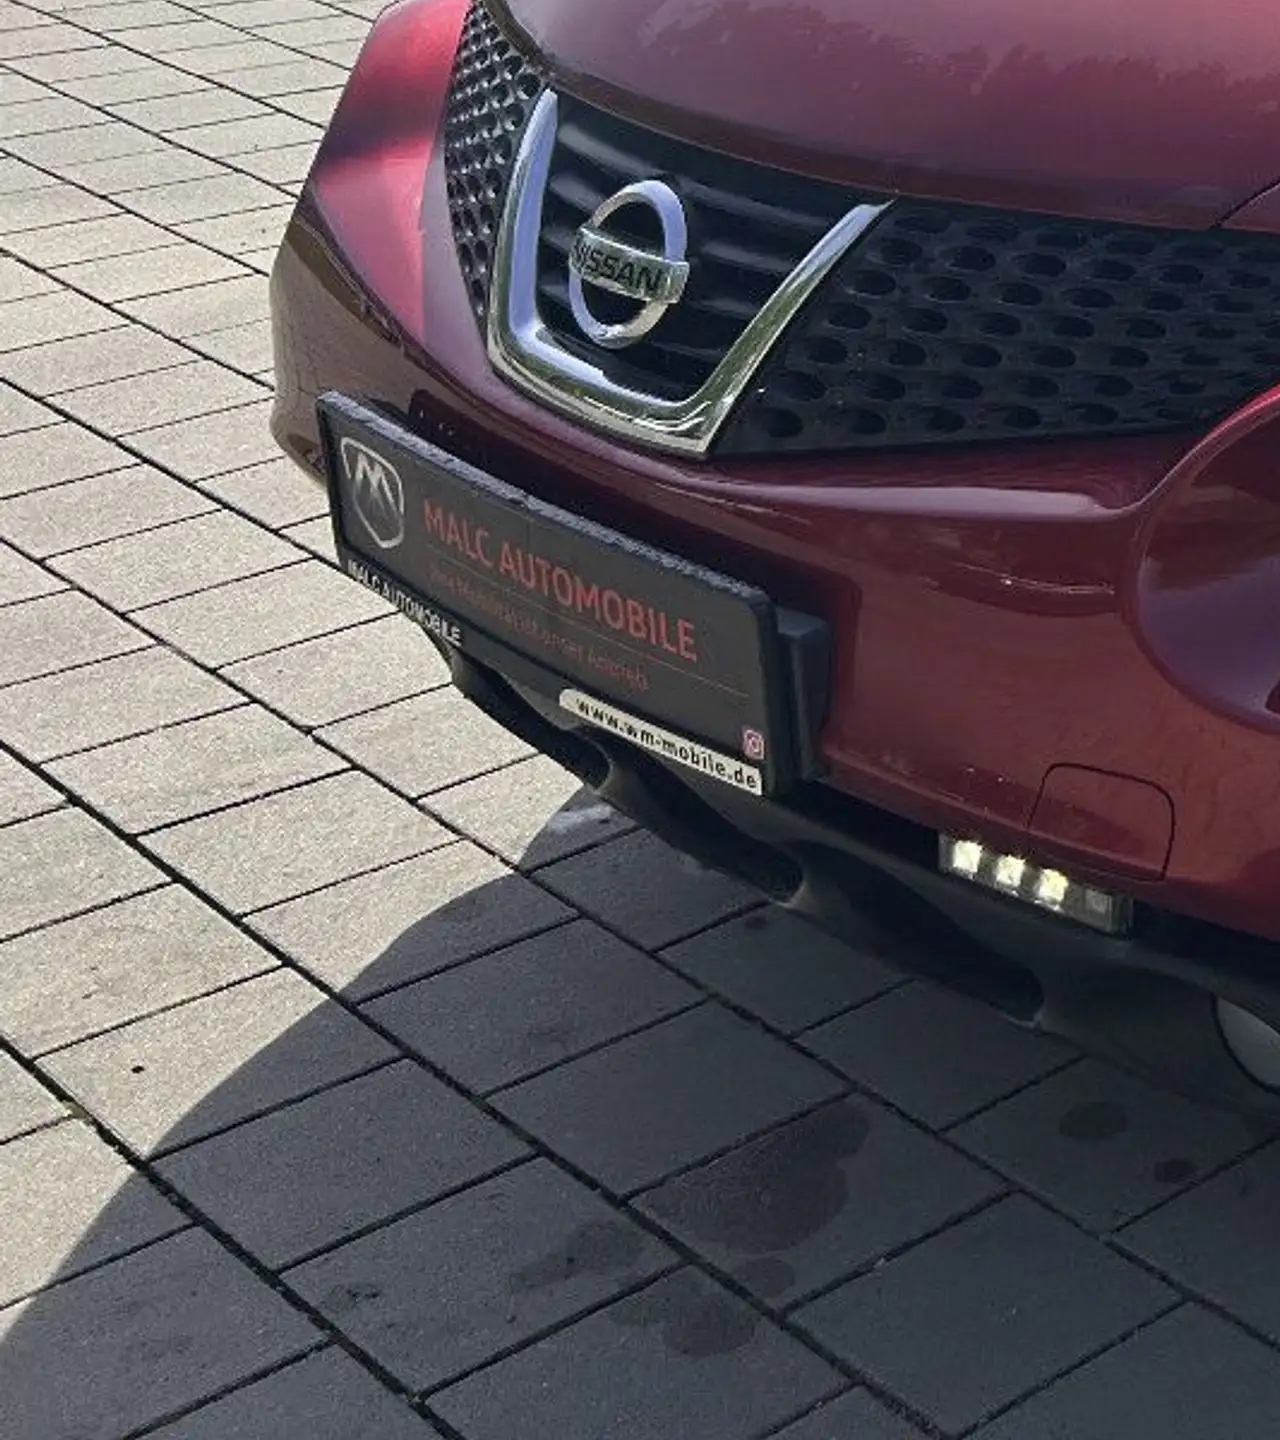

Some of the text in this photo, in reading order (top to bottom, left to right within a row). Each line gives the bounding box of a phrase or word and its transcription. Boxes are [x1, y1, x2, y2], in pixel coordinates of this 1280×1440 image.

[574, 238, 665, 293] NISSAN
[381, 580, 462, 648] AUTOMOBILE
[424, 498, 493, 568] MALC
[499, 541, 698, 663] AUTOMOBILE
